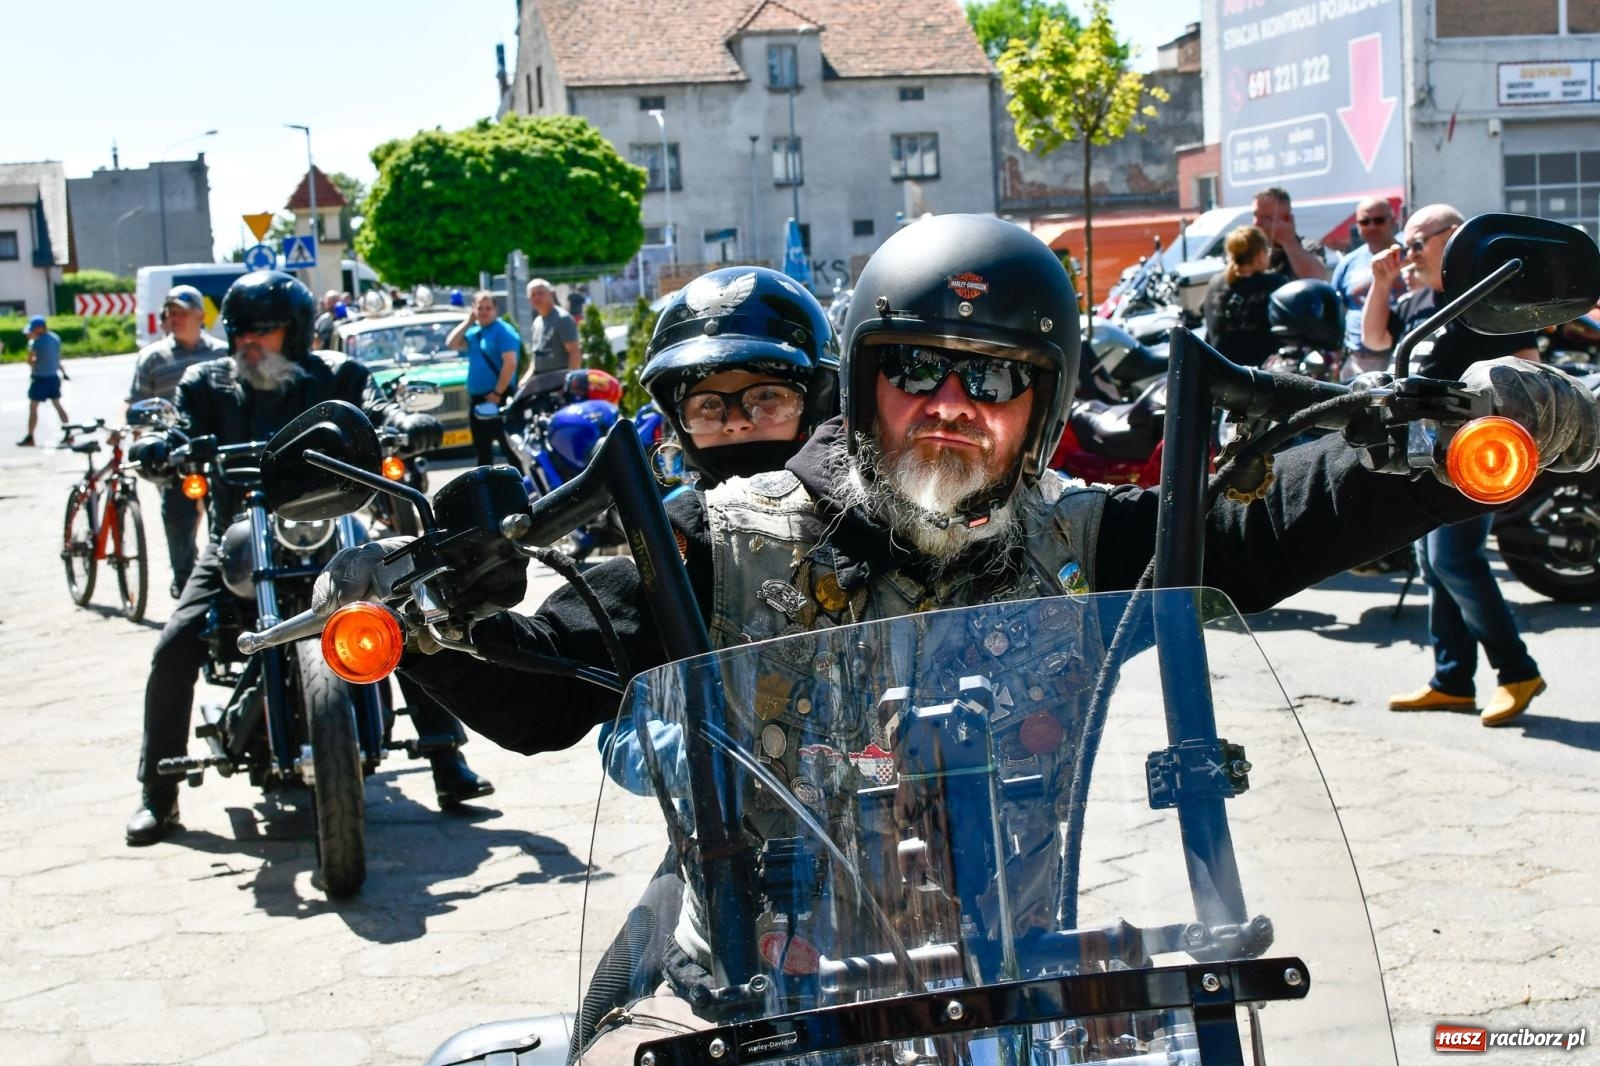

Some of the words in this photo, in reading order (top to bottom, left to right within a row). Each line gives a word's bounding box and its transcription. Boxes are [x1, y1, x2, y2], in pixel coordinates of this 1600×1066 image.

[1319, 0, 1391, 22] POJAZ
[1249, 69, 1271, 98] 691
[1274, 62, 1298, 92] 221
[1302, 54, 1330, 87] 222
